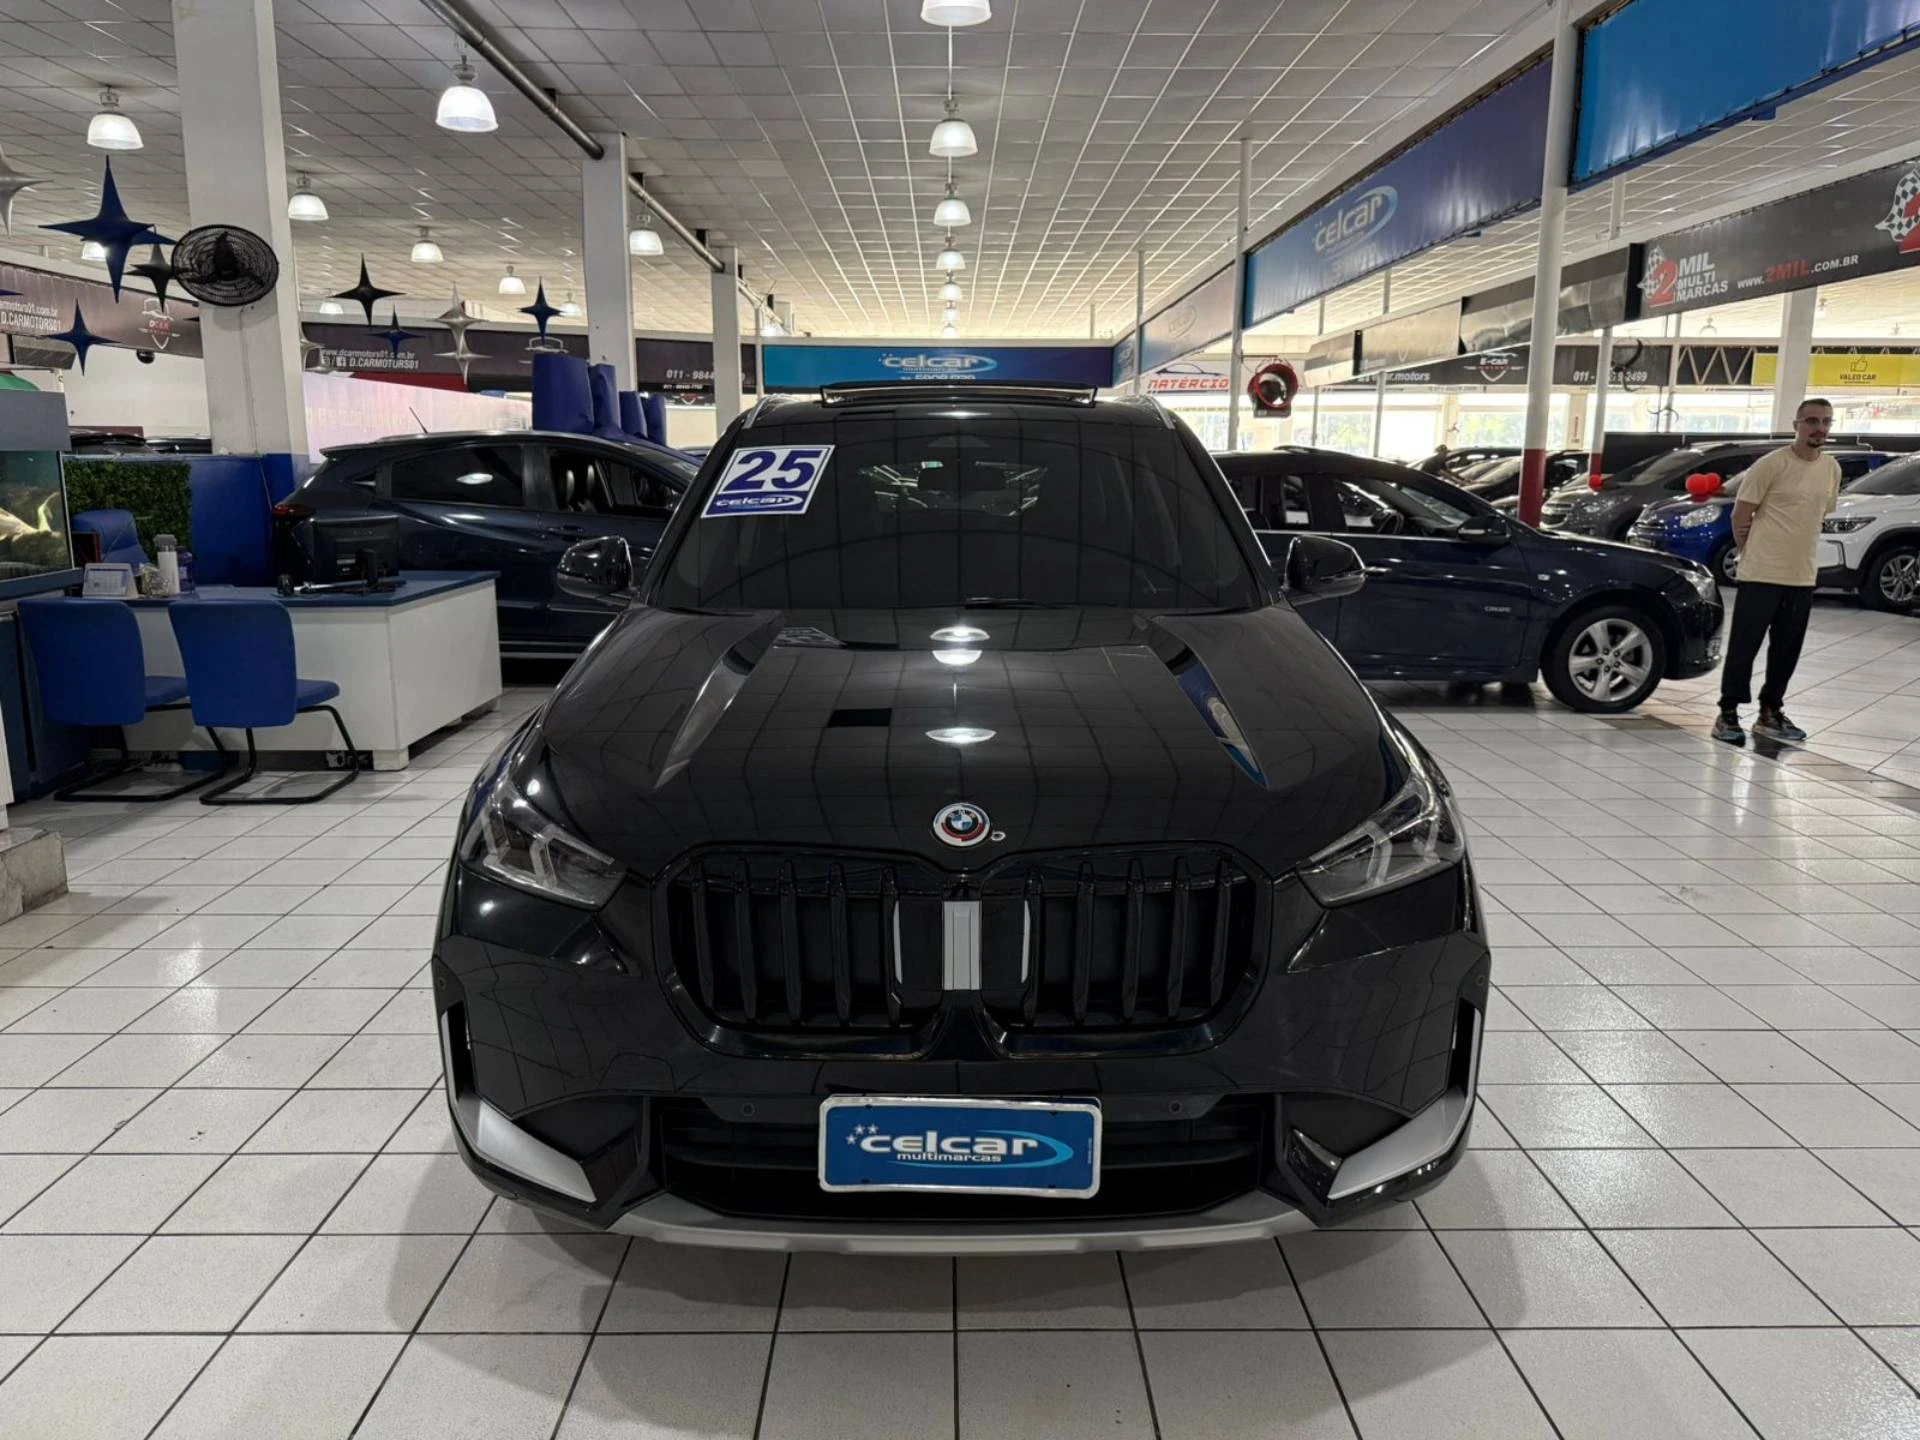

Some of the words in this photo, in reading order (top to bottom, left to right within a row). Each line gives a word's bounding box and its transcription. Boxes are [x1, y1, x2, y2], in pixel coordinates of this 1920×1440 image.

[1315, 195, 1383, 252] celcar
[1679, 252, 1715, 277] MIL
[1677, 270, 1716, 291] MULTI
[1677, 280, 1729, 303] MARCAS
[321, 349, 416, 360] www.dcarmotors01.cm.br
[882, 355, 979, 368] celcar
[666, 369, 684, 380] 011
[1573, 370, 1589, 382] 011
[723, 450, 821, 490] 25
[716, 496, 792, 507] celcar
[860, 1131, 1039, 1155] celcar
[897, 1152, 1001, 1163] multimarcas
